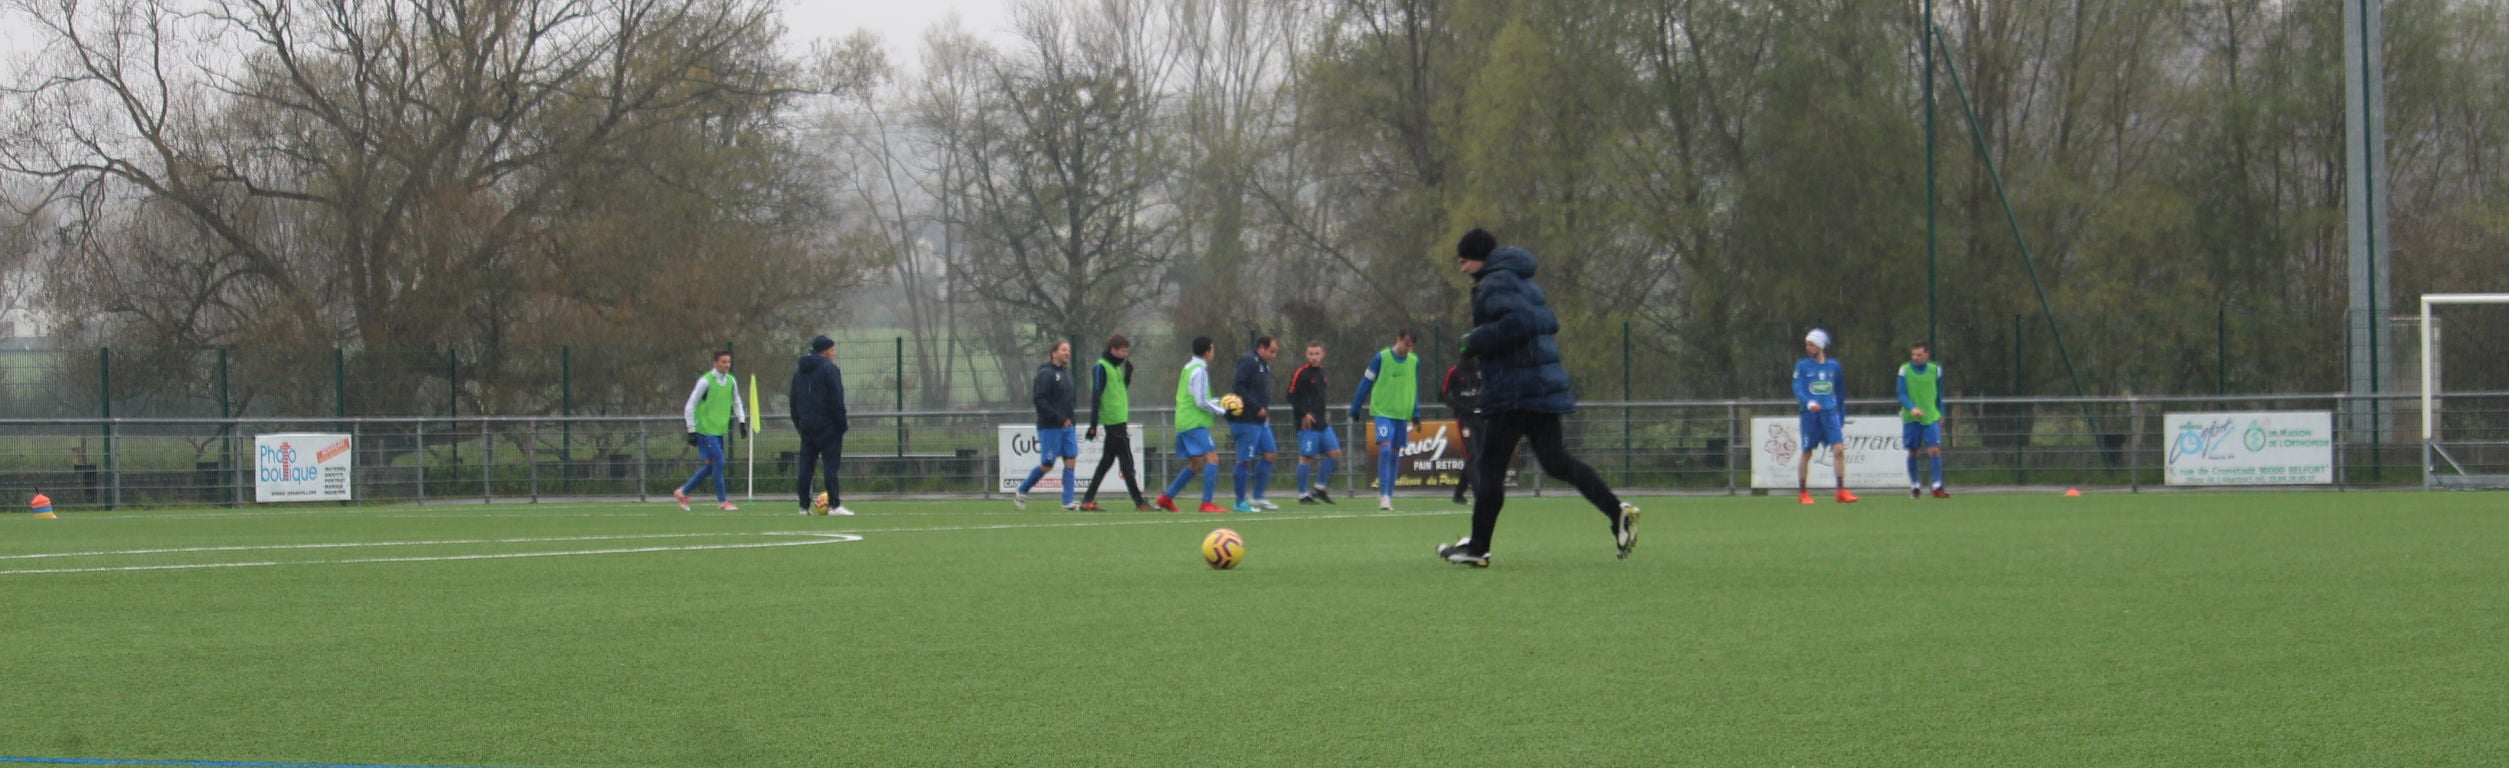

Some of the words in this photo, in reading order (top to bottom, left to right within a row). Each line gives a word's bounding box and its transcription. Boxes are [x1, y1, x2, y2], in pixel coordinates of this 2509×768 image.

[260, 442, 297, 464] Photo
[1414, 461, 1432, 472] PAIN
[1436, 460, 1465, 471] RETRO
[2288, 465, 2325, 474] BELFORT
[260, 464, 318, 486] boutique
